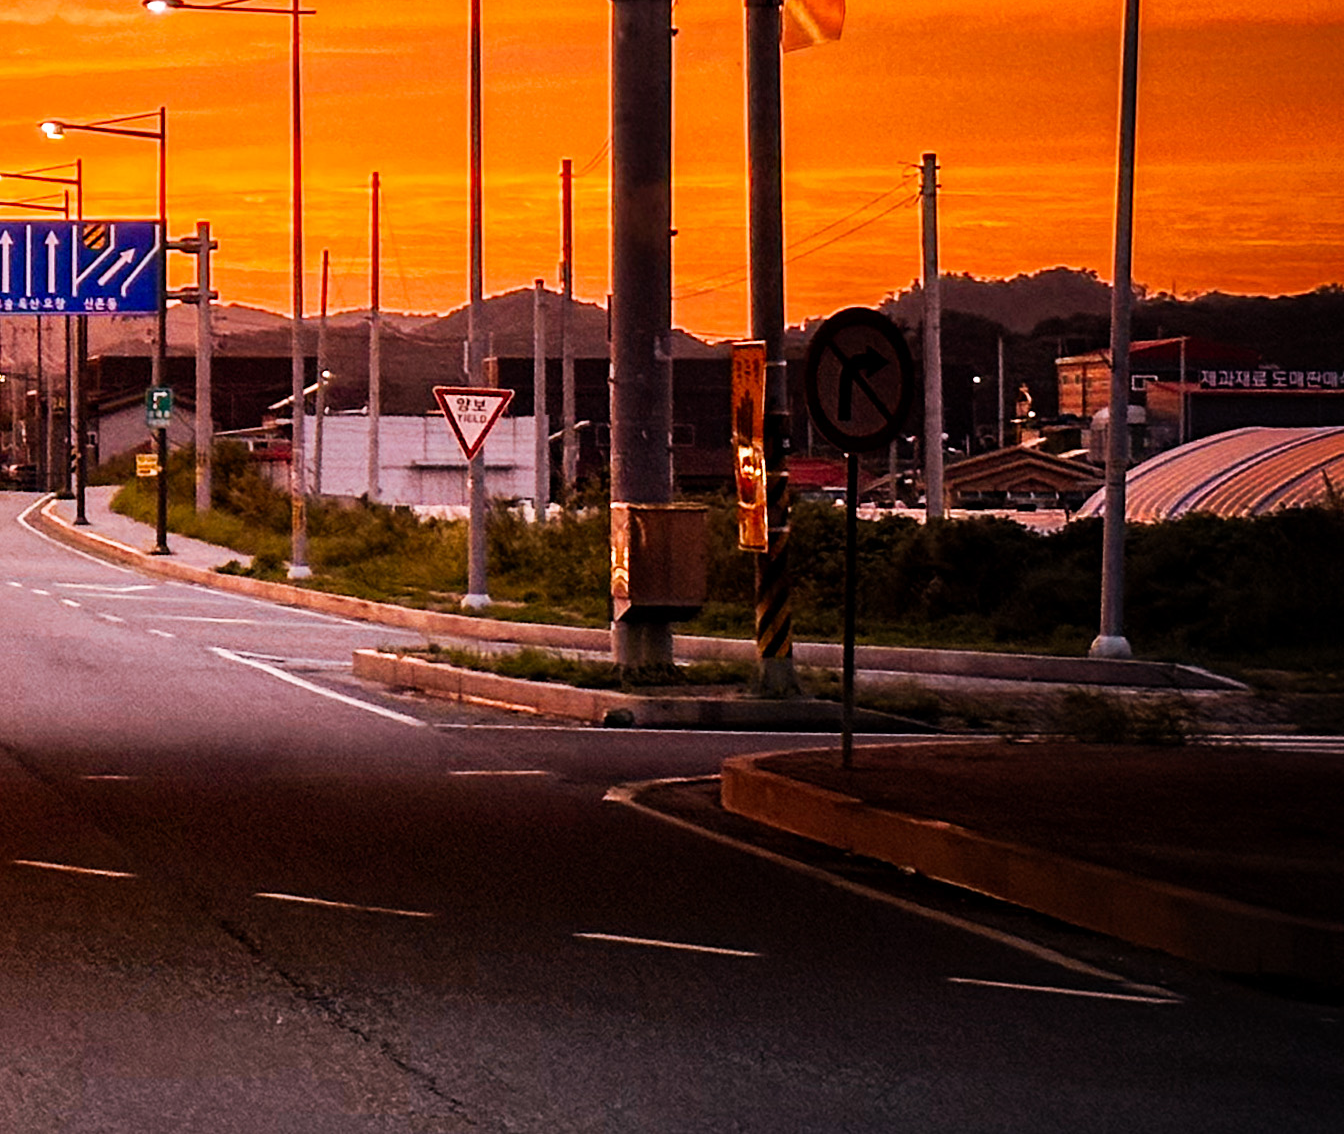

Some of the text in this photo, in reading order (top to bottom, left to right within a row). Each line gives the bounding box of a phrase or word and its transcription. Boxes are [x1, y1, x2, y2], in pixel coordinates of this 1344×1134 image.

[1272, 370, 1344, 389] 도매판매
[456, 397, 487, 412] 양보
[457, 414, 487, 424] YIELD
